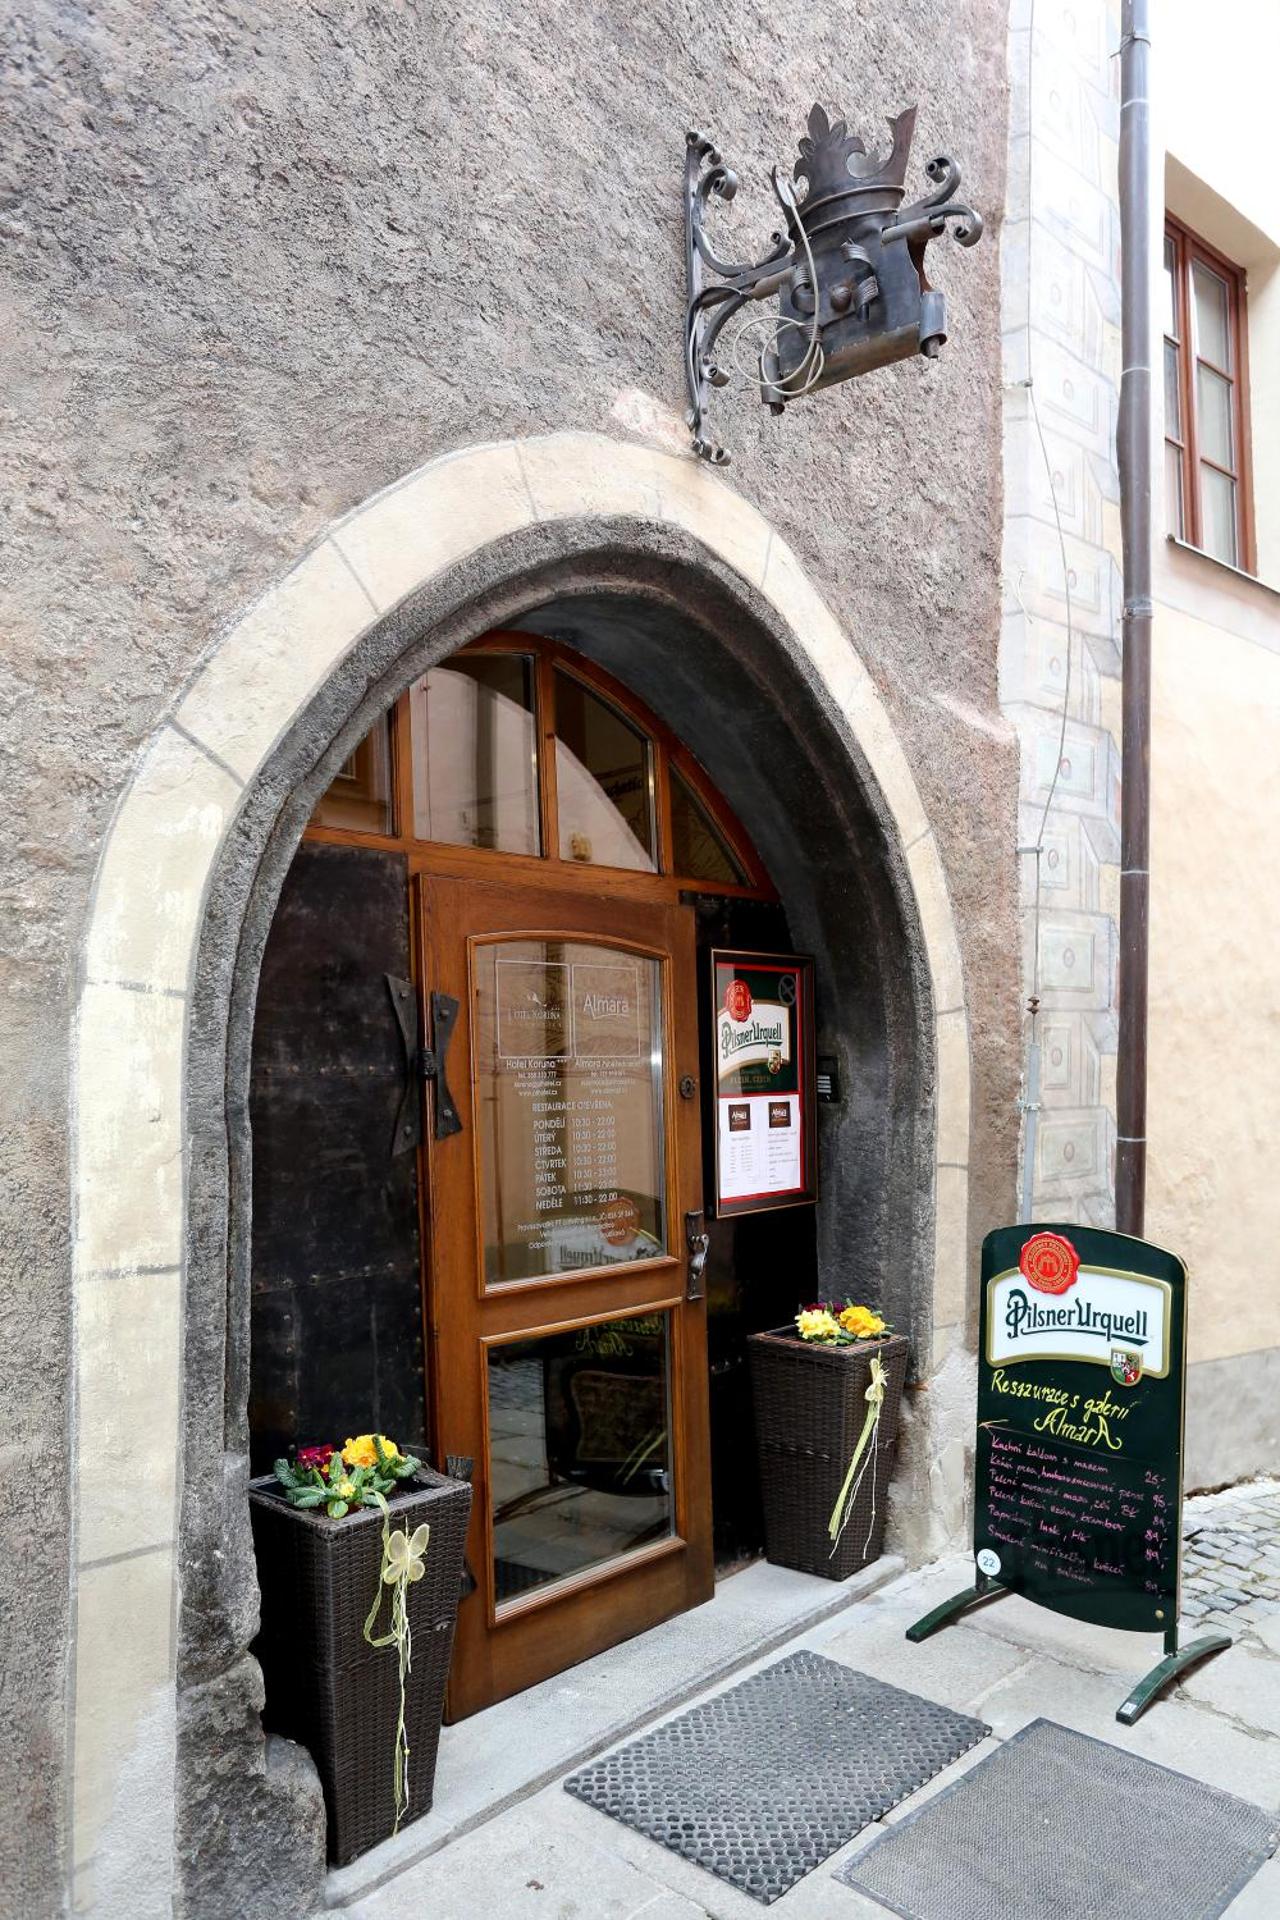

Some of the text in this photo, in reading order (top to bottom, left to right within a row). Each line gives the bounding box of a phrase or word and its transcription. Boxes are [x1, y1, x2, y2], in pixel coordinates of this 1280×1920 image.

[583, 994, 629, 1017] Almara
[722, 1020, 782, 1059] Pilsner Urquell
[506, 1059, 556, 1069] Hotel Koruna
[532, 1101, 575, 1112] RESTAURACE
[536, 1186, 566, 1197] SOBOTA
[535, 1197, 563, 1210] NEDĚLE
[1005, 1288, 1148, 1342] Pilsner Urquell
[1070, 1395, 1080, 1408] s
[982, 1555, 996, 1568] 22
